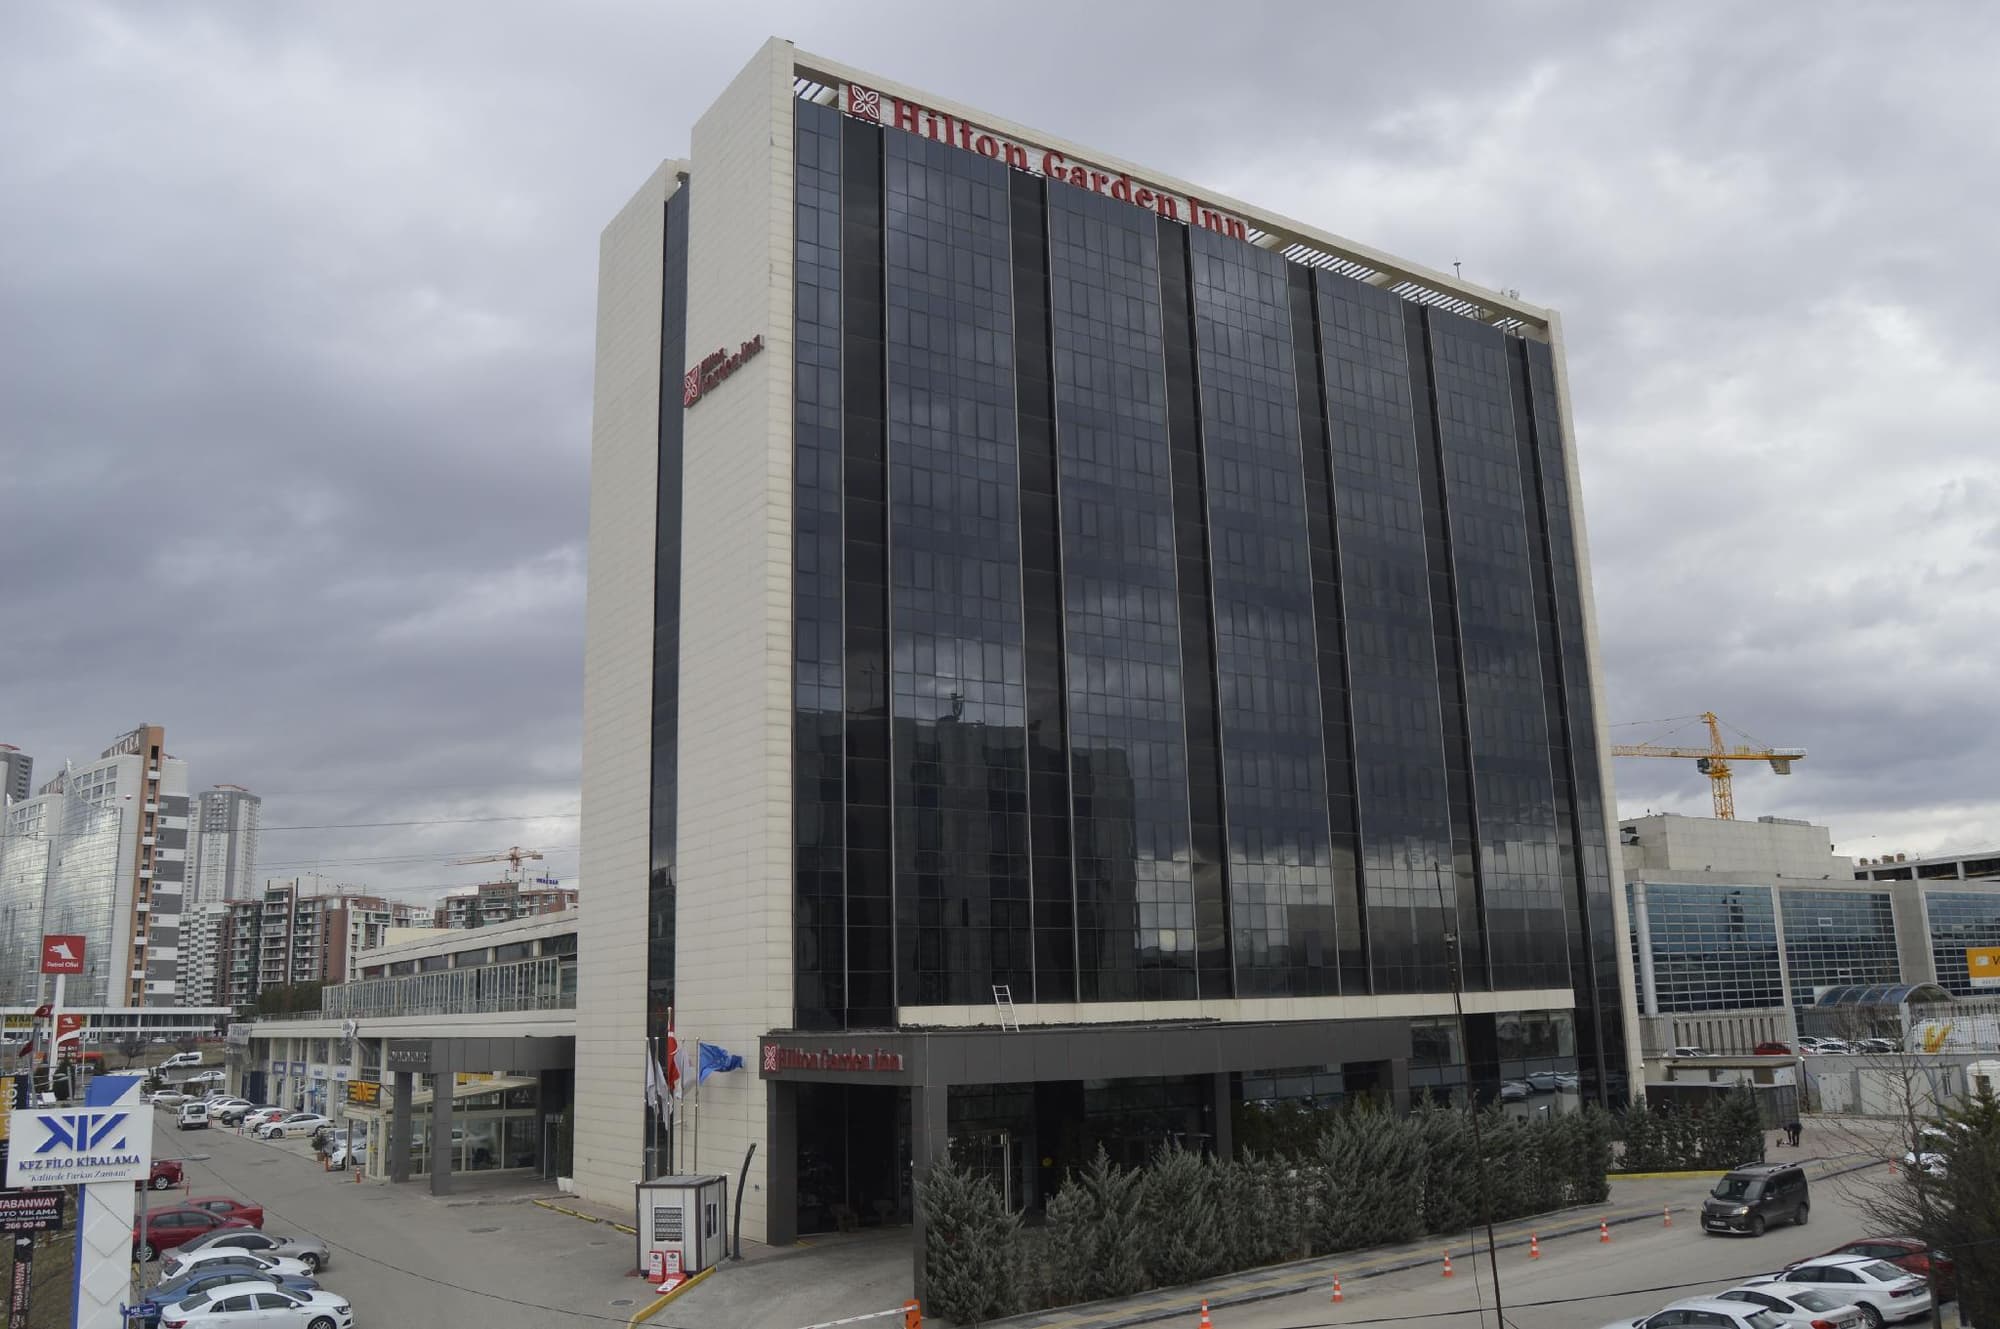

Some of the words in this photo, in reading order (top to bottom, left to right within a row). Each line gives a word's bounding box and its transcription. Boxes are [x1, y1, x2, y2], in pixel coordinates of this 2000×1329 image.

[892, 98, 1030, 171] Hilton
[1042, 149, 1177, 219] Garden
[1187, 196, 1247, 242] Inn
[19, 1159, 43, 1171] KFZ
[45, 1156, 73, 1170] FİLO
[76, 1154, 140, 1169] KİRALAMA
[0, 1198, 57, 1209] TABANWAY
